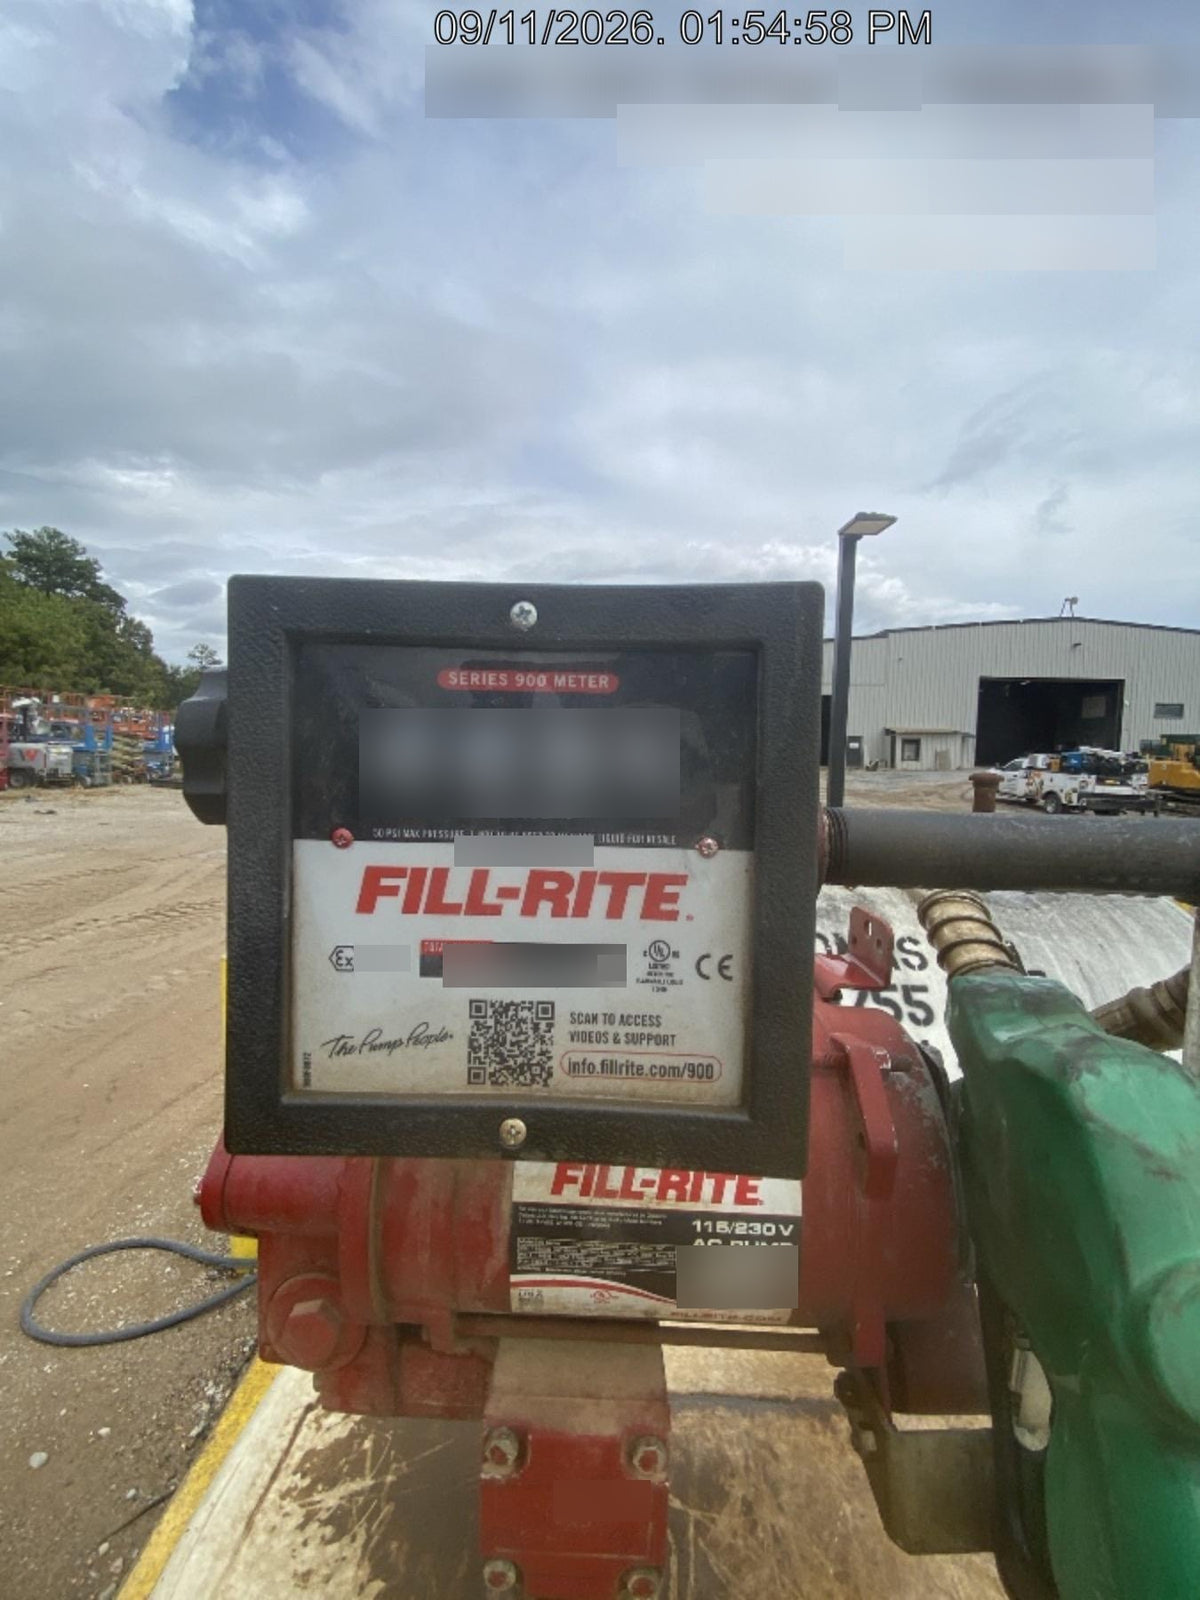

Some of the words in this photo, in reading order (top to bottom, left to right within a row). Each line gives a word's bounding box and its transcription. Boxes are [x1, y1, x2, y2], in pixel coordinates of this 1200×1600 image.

[448, 671, 508, 686] SERIES
[515, 673, 547, 688] 900
[553, 674, 609, 689] METER
[355, 865, 689, 921] FILL-RITE
[569, 1011, 598, 1025] SCAN
[602, 1012, 616, 1026] TO
[618, 1013, 662, 1028] ACCESS
[320, 1034, 354, 1058] The
[359, 1028, 404, 1056] Pump
[568, 1030, 609, 1044] VIDEOS
[612, 1032, 621, 1045] &
[624, 1032, 676, 1047] SUPPORT
[567, 1057, 715, 1080] info.fillrite.com/900
[550, 1161, 764, 1206] FILL-RITE
